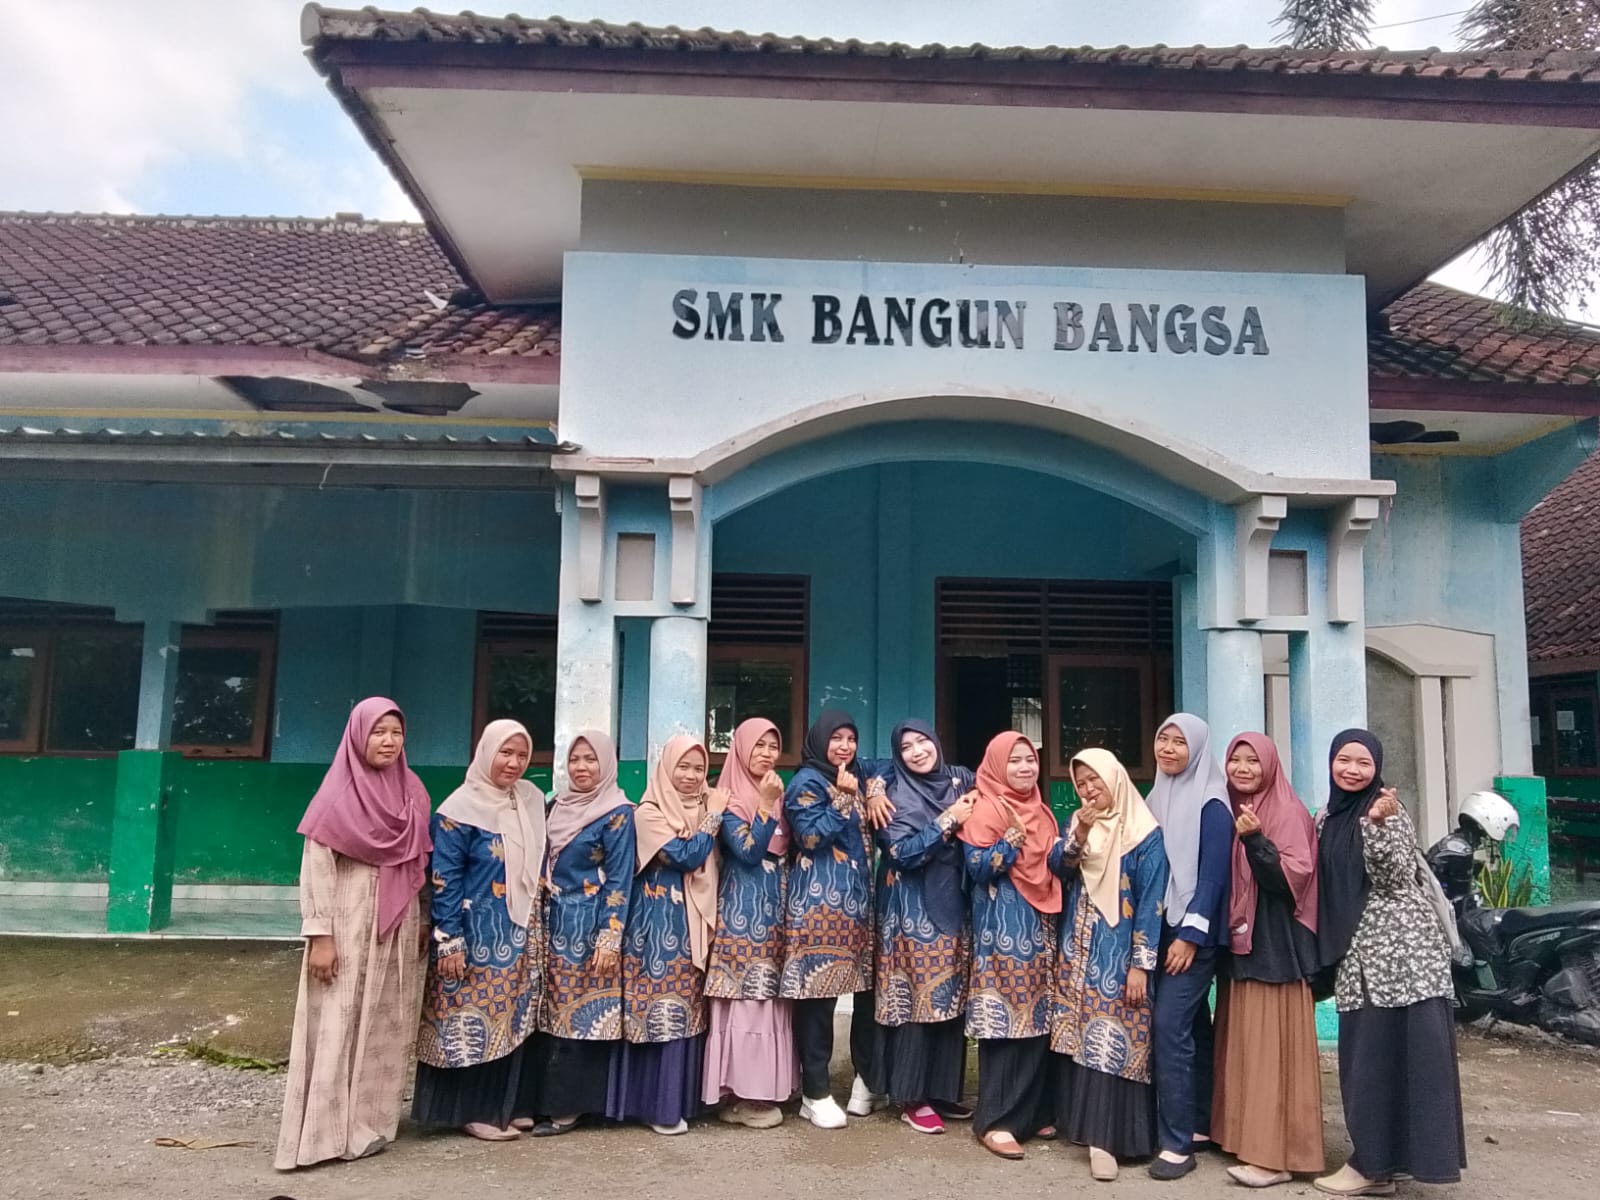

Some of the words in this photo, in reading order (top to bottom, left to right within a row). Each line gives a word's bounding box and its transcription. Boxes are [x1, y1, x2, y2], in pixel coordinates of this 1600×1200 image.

[672, 288, 784, 342] SMK
[811, 294, 1025, 350] BANGUN
[1054, 301, 1269, 356] BANGSA
